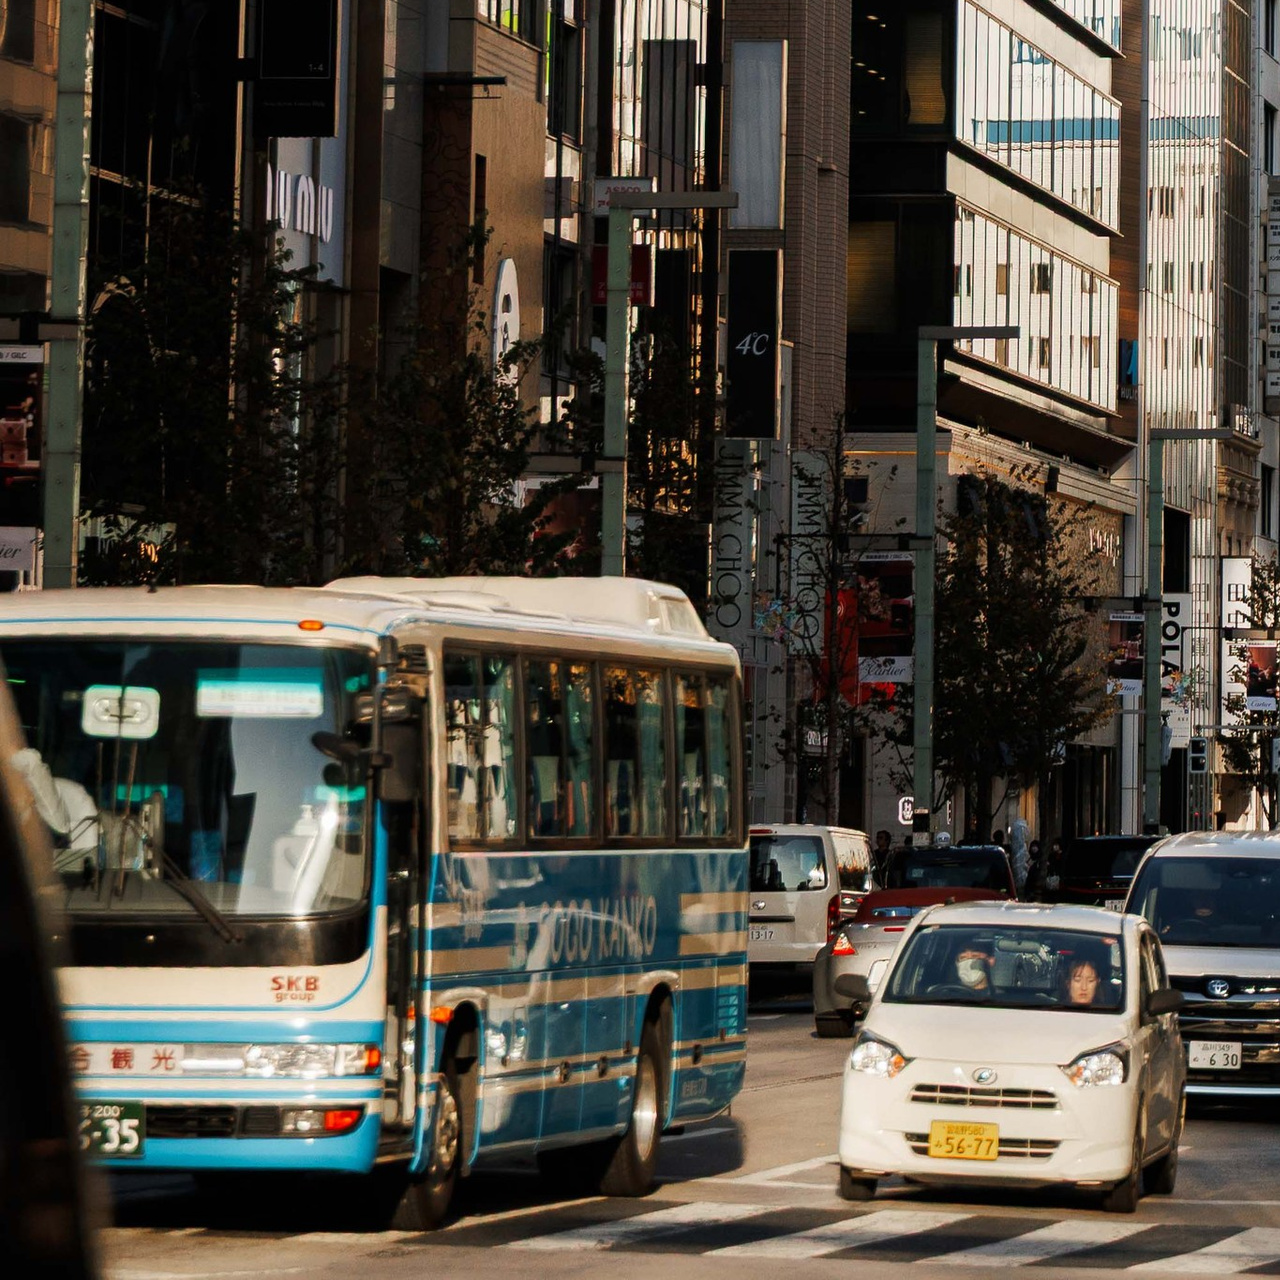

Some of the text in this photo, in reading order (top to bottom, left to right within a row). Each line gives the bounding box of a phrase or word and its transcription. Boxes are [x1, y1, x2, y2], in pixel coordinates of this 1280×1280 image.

[1161, 601, 1180, 678] POLA
[271, 975, 320, 991] SKB
[275, 991, 315, 1003] group
[945, 1138, 993, 1153] 56-77
